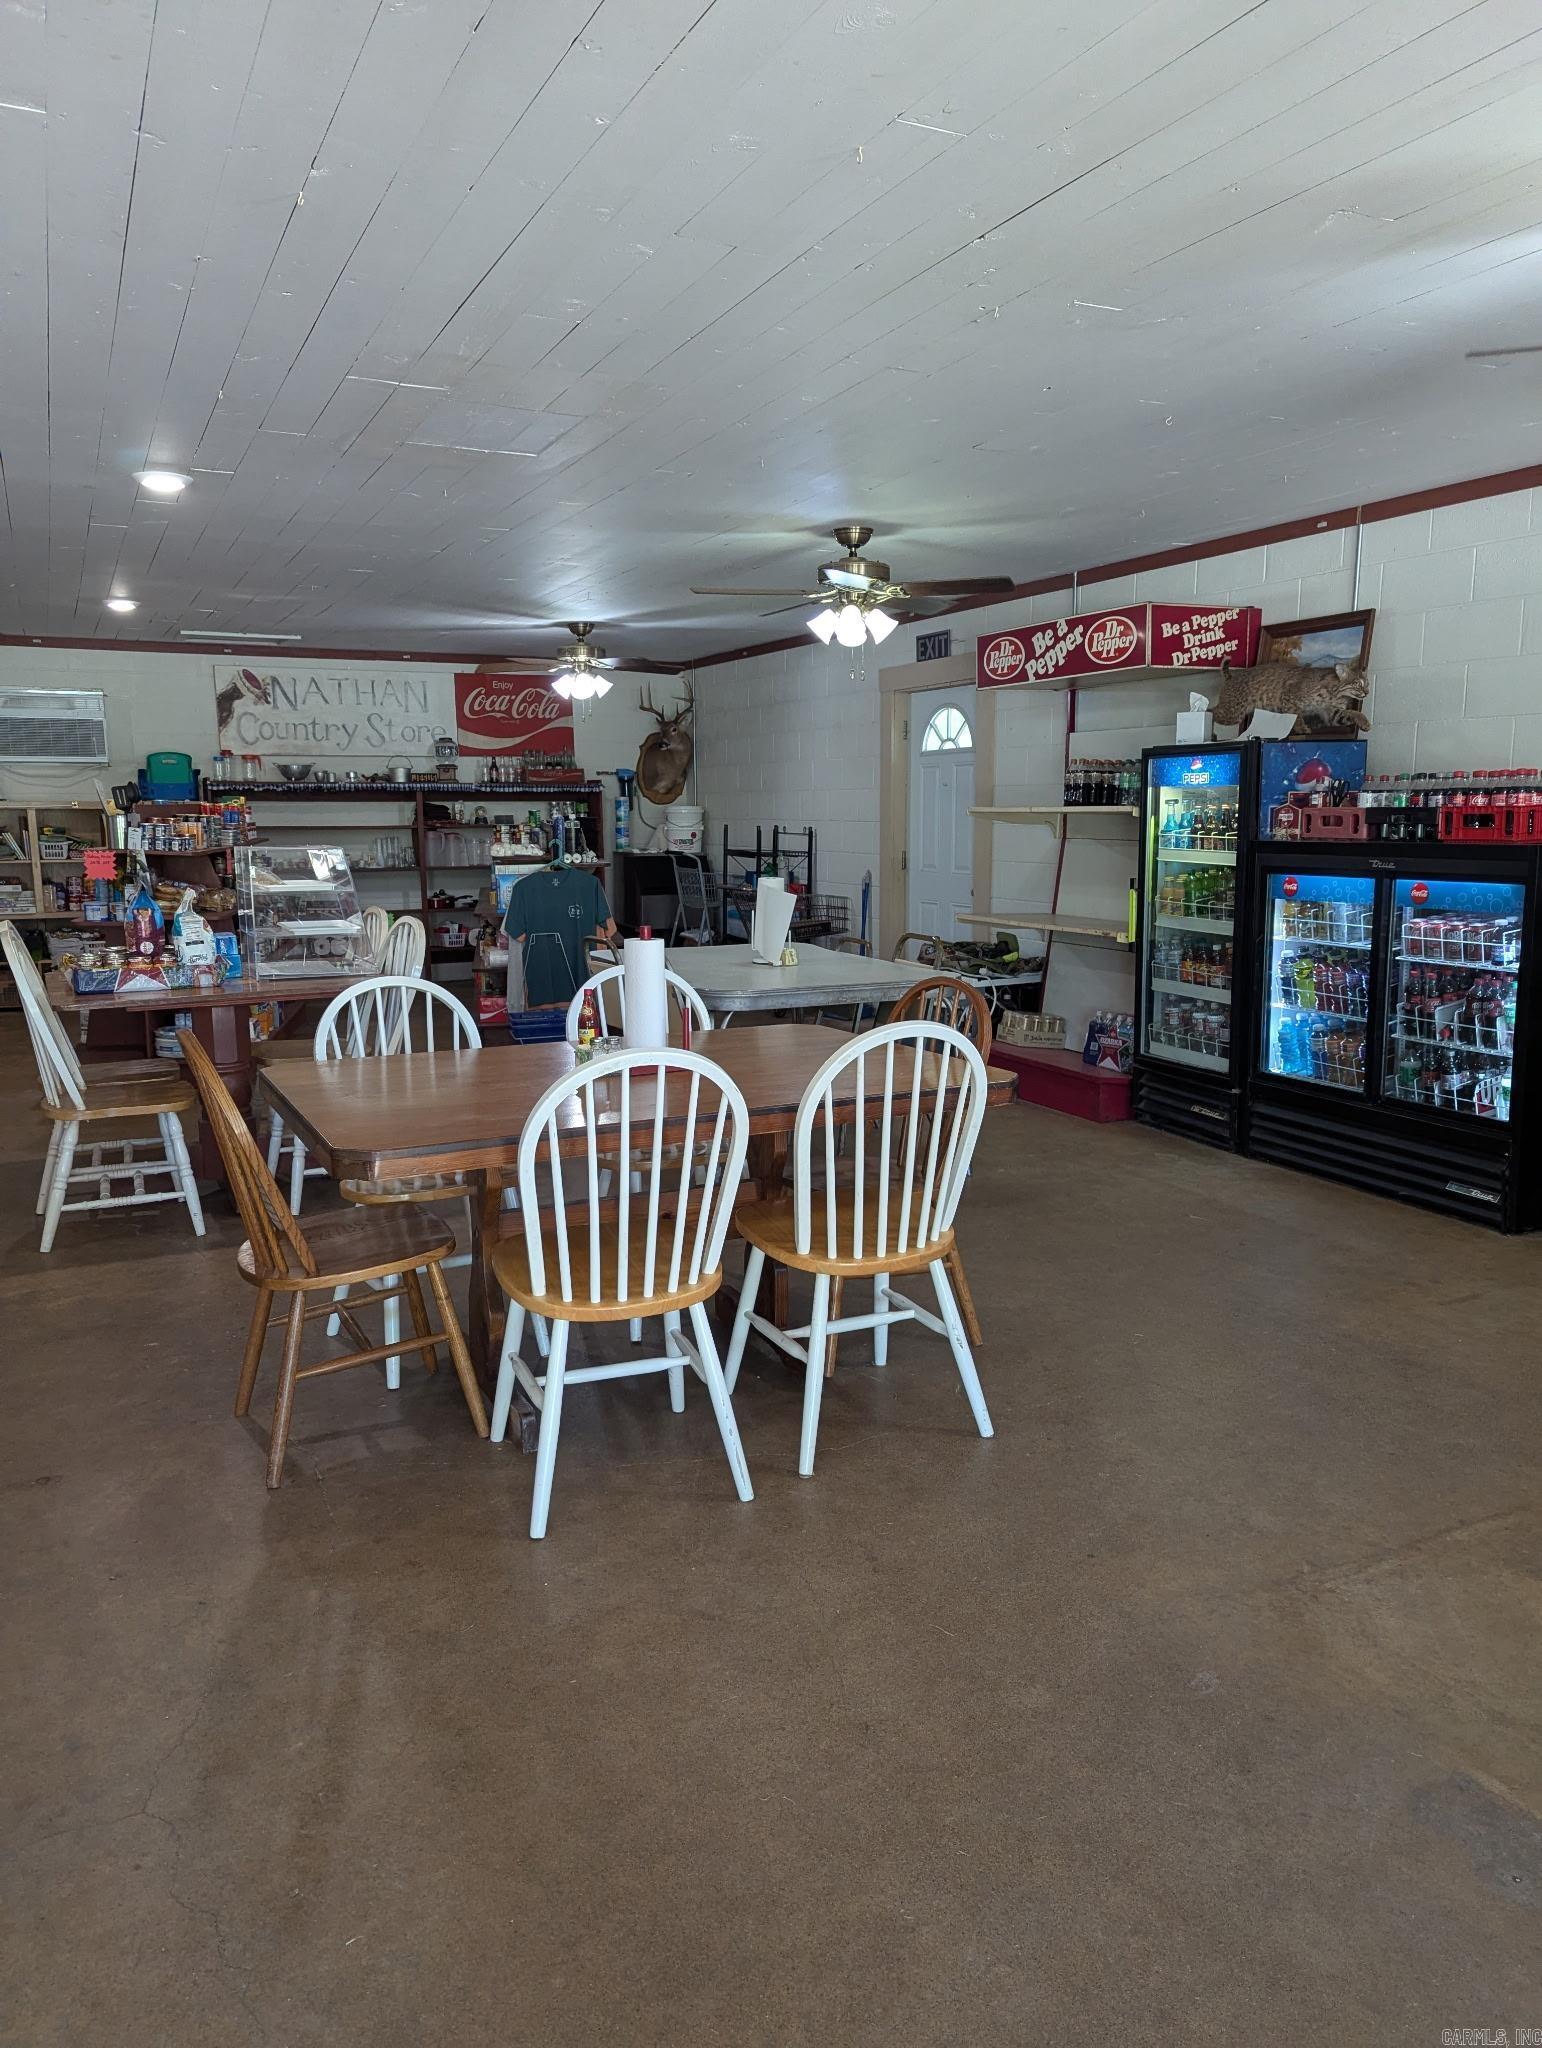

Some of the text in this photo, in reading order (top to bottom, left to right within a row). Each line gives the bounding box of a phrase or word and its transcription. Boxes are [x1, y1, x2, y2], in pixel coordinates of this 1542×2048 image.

[1105, 621, 1123, 638] Dr
[1161, 608, 1239, 638] Be a Pepper
[918, 635, 948, 660] EXIT
[1000, 641, 1014, 657] Dr
[1031, 619, 1069, 657] Be a
[1091, 633, 1134, 658] Pepper
[1183, 626, 1226, 649] Drink
[988, 651, 1022, 674] Pepper
[1025, 625, 1084, 682] Pepper
[1171, 639, 1238, 666] Dr Pepper
[270, 675, 430, 713] NATHAN
[492, 680, 514, 691] Enjoy
[463, 687, 560, 719] Coca-Cola
[237, 712, 447, 751] Country Store
[1183, 773, 1210, 784] PEPSI
[1369, 860, 1395, 868] True
